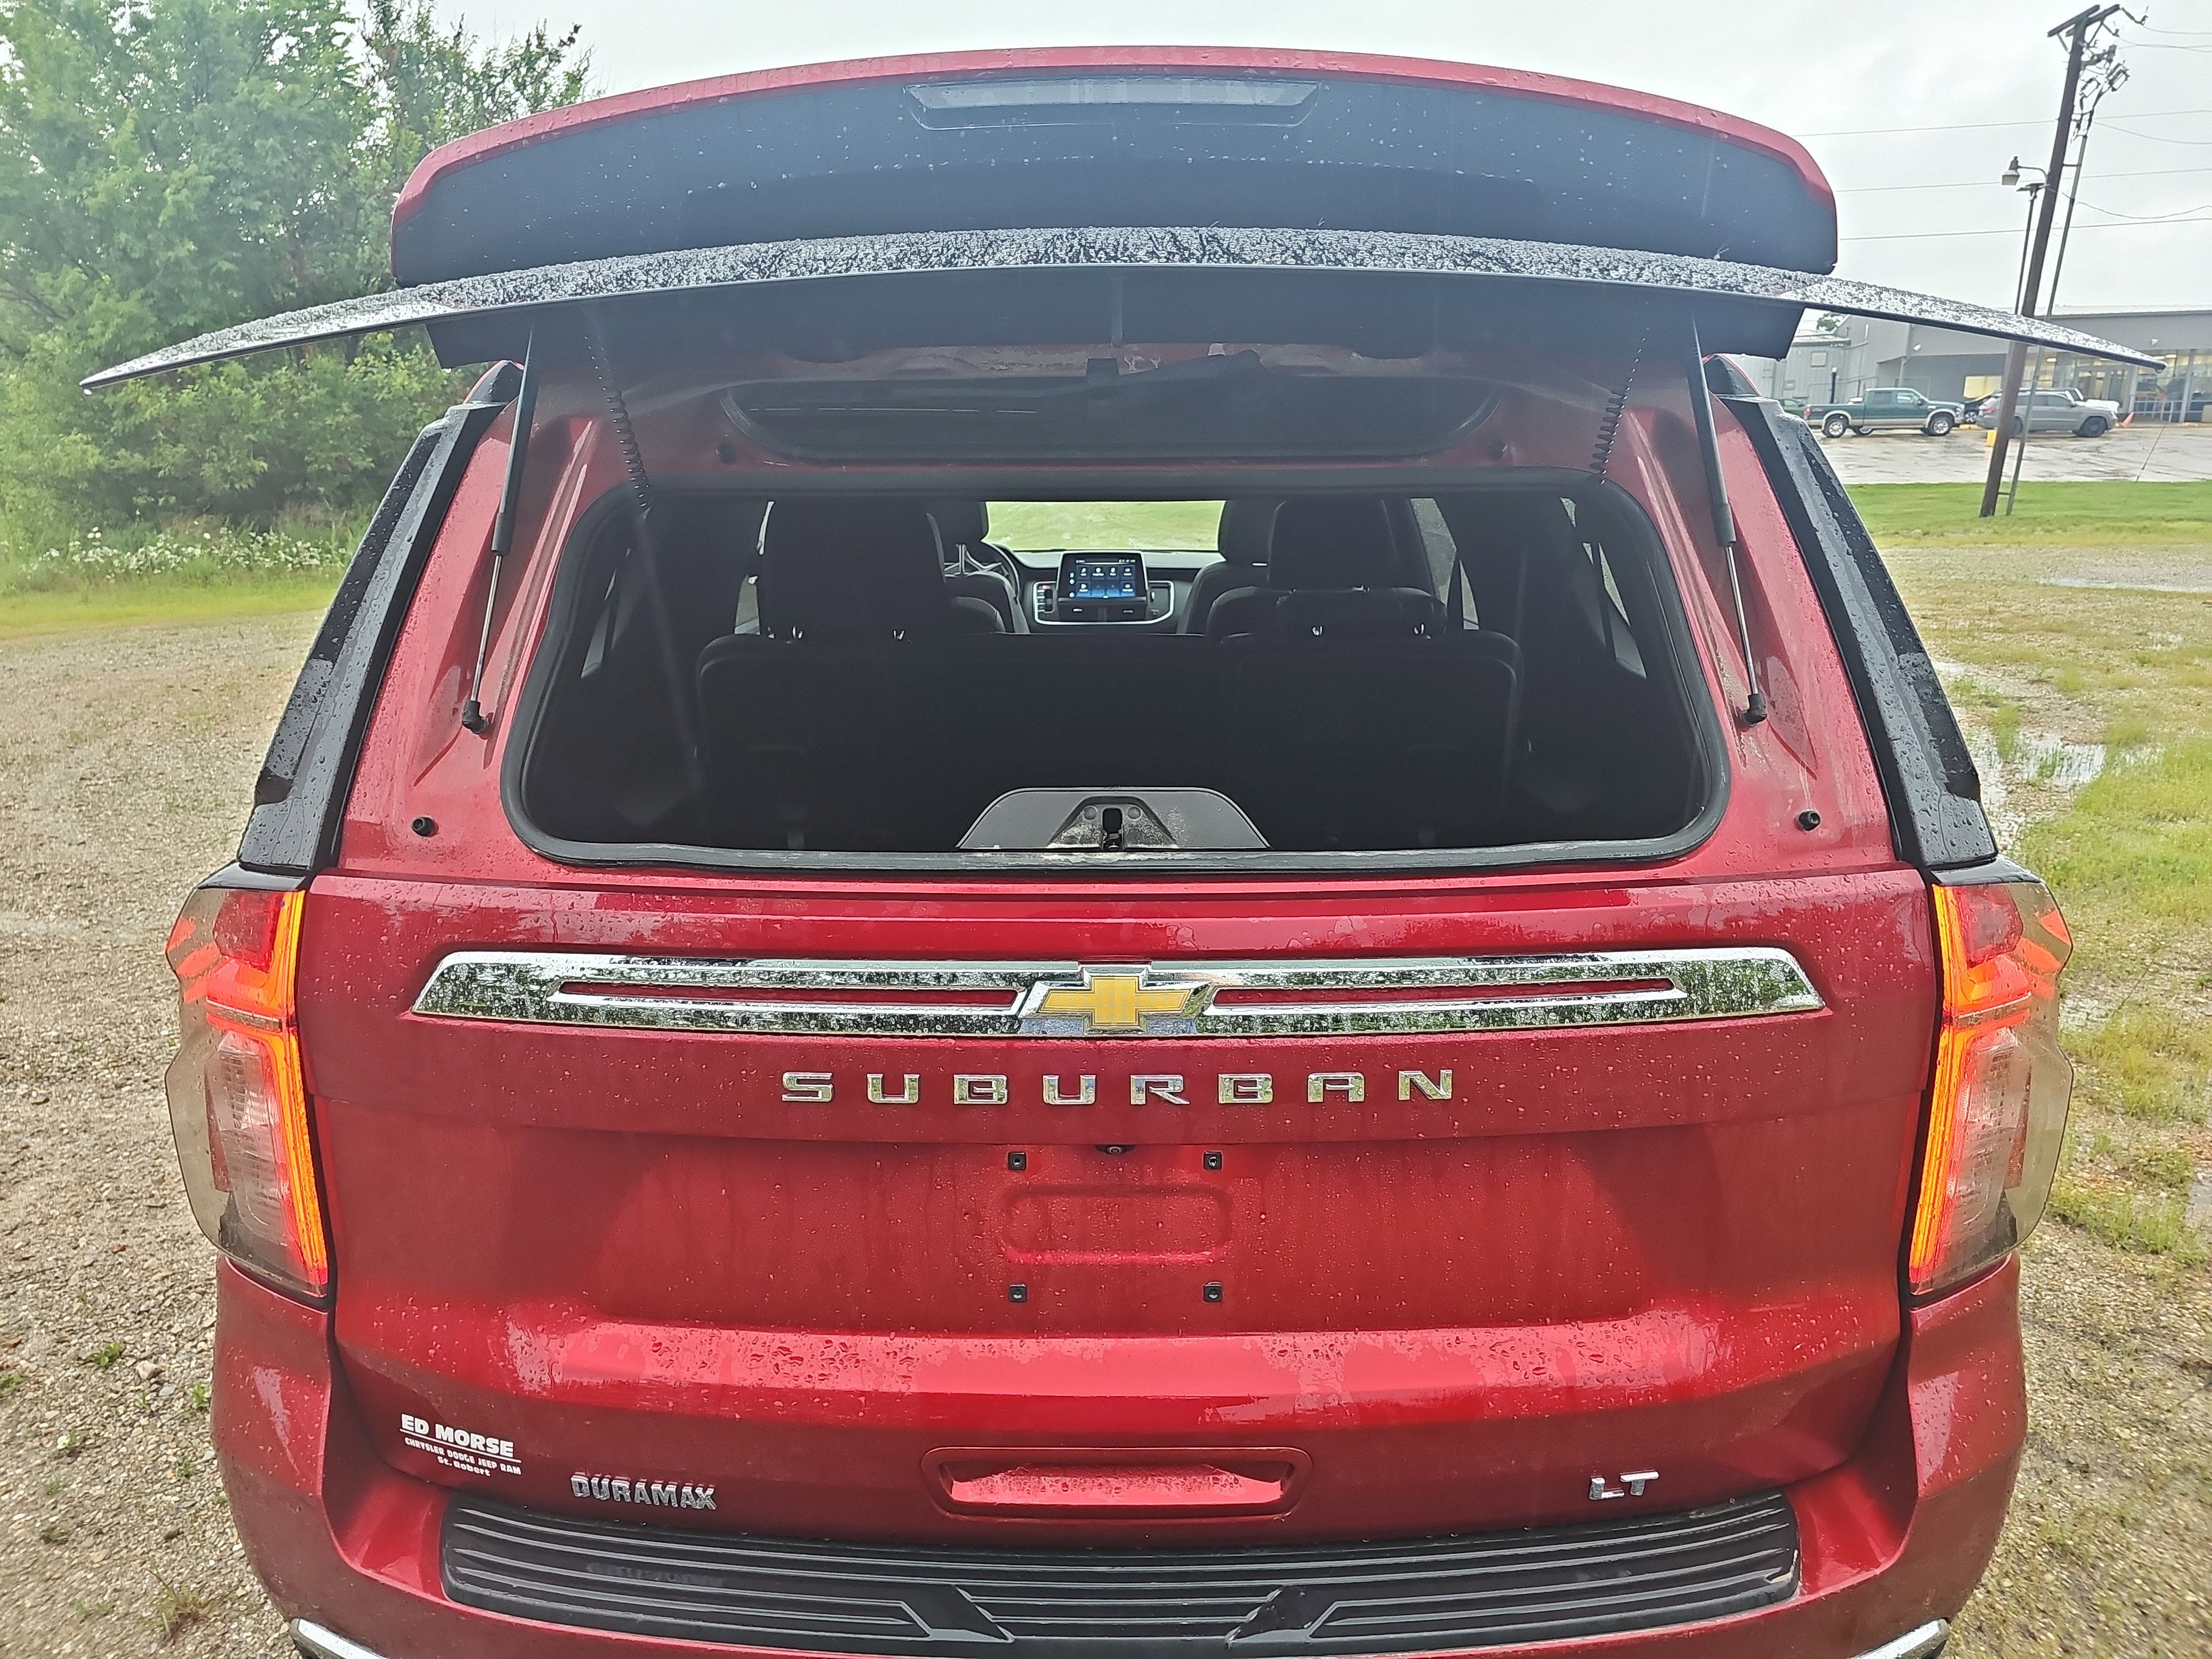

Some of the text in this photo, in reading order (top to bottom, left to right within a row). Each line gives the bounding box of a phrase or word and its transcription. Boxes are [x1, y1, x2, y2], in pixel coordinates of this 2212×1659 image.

[781, 1070, 1454, 1105] SUBURBAN
[401, 1413, 513, 1458] ED MORSE
[404, 1437, 522, 1475] CHRYSLER DODGE JEEP RAM
[437, 1456, 491, 1477] St. Robert
[570, 1475, 717, 1510] DURAMAX
[1589, 1471, 1660, 1500] LT
